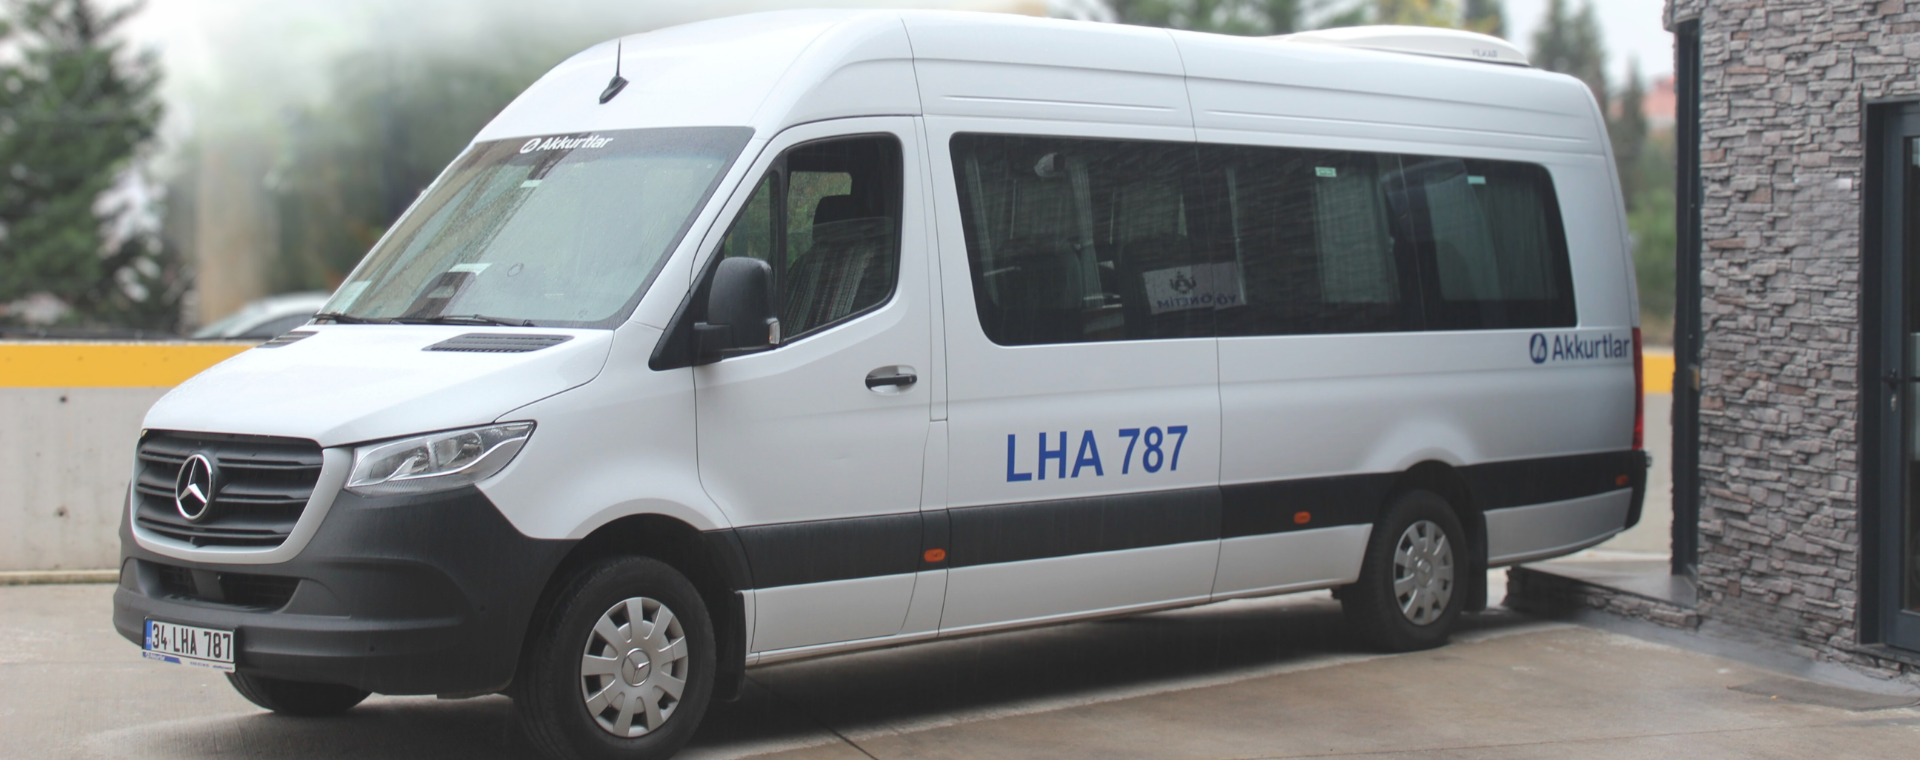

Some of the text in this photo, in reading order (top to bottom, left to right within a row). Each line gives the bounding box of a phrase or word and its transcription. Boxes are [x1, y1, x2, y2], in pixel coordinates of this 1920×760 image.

[536, 134, 614, 151] Akkurtlar
[1552, 332, 1630, 361] Akkurtlar
[1006, 425, 1188, 483] LHA 787
[153, 623, 168, 651] 34
[173, 626, 198, 656] LHA
[203, 631, 232, 660] 787
